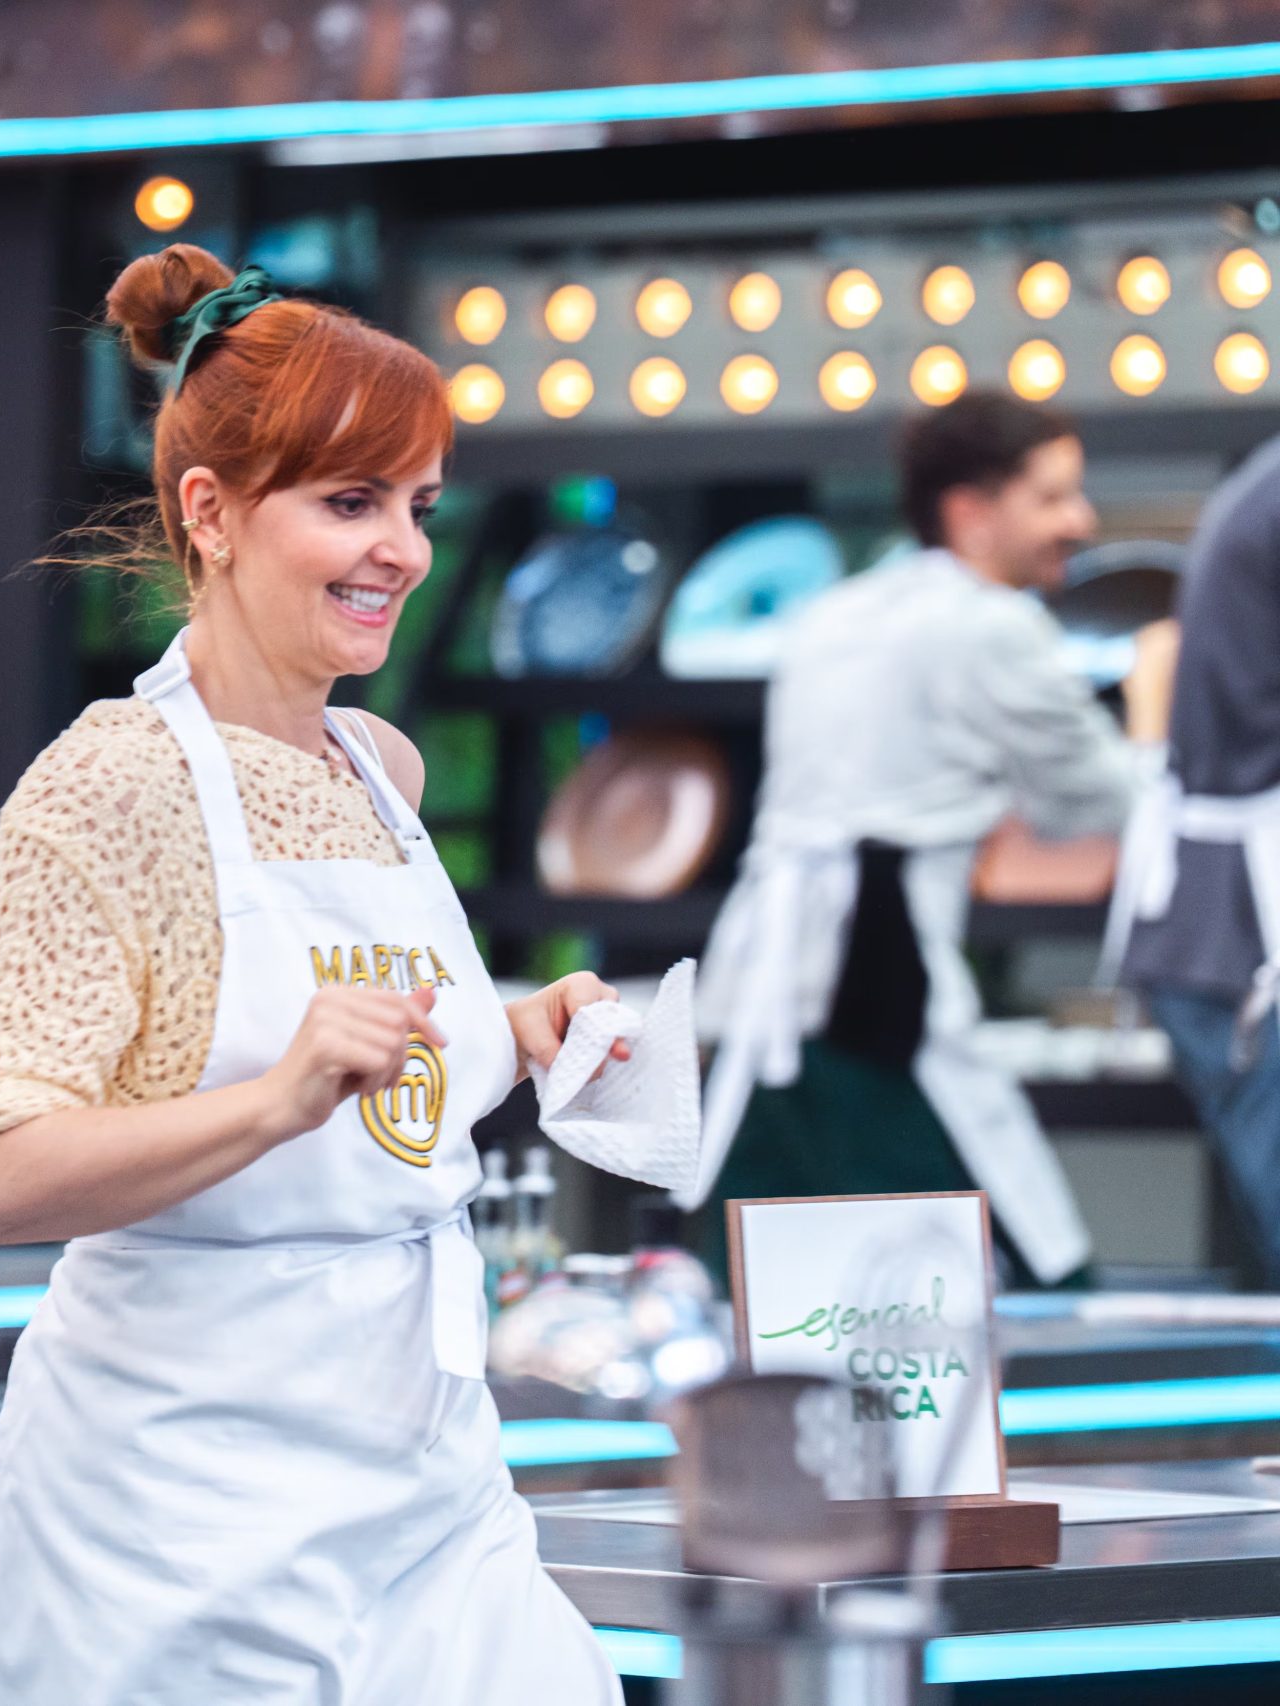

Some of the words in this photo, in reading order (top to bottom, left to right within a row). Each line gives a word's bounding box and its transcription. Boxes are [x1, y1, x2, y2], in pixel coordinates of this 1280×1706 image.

[757, 1276, 945, 1351] esencial
[848, 1348, 968, 1381] COSTA
[851, 1386, 940, 1422] RICA
